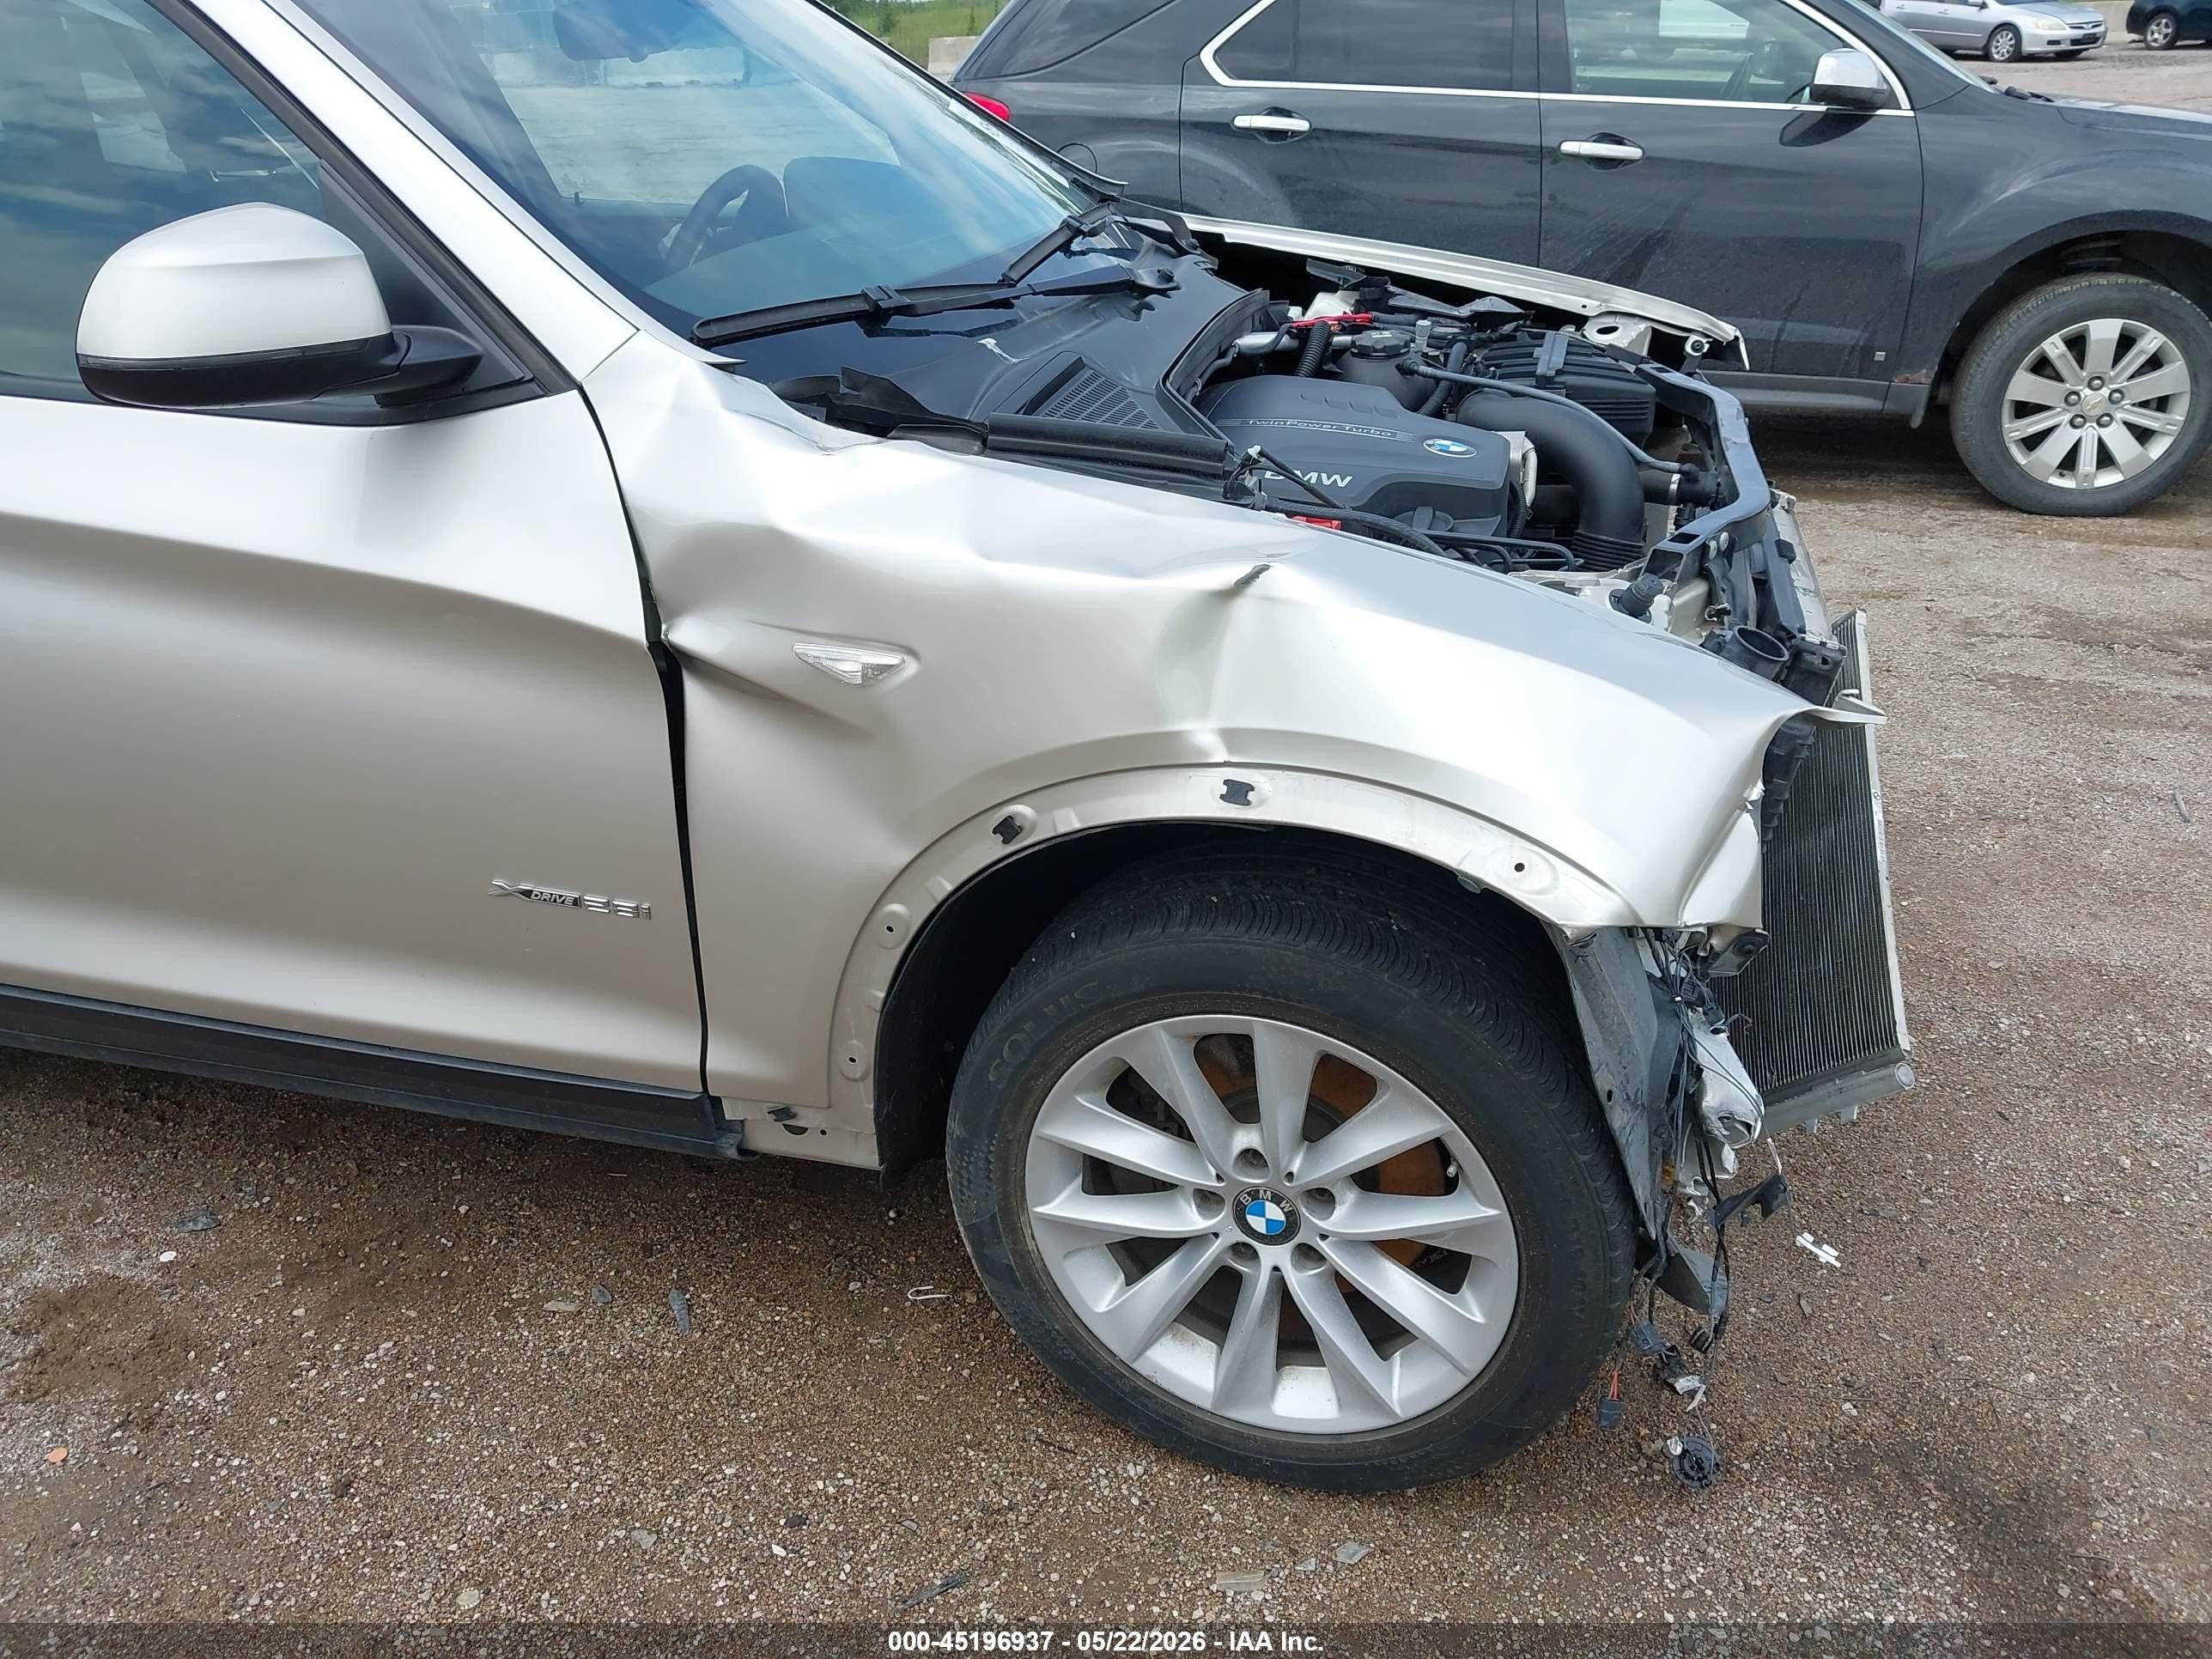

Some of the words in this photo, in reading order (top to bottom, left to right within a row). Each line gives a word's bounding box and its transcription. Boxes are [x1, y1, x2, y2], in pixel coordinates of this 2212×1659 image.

[1247, 418, 1338, 431] TwinPower
[1341, 425, 1392, 436] Turbo
[1239, 1189, 1294, 1212] BMW
